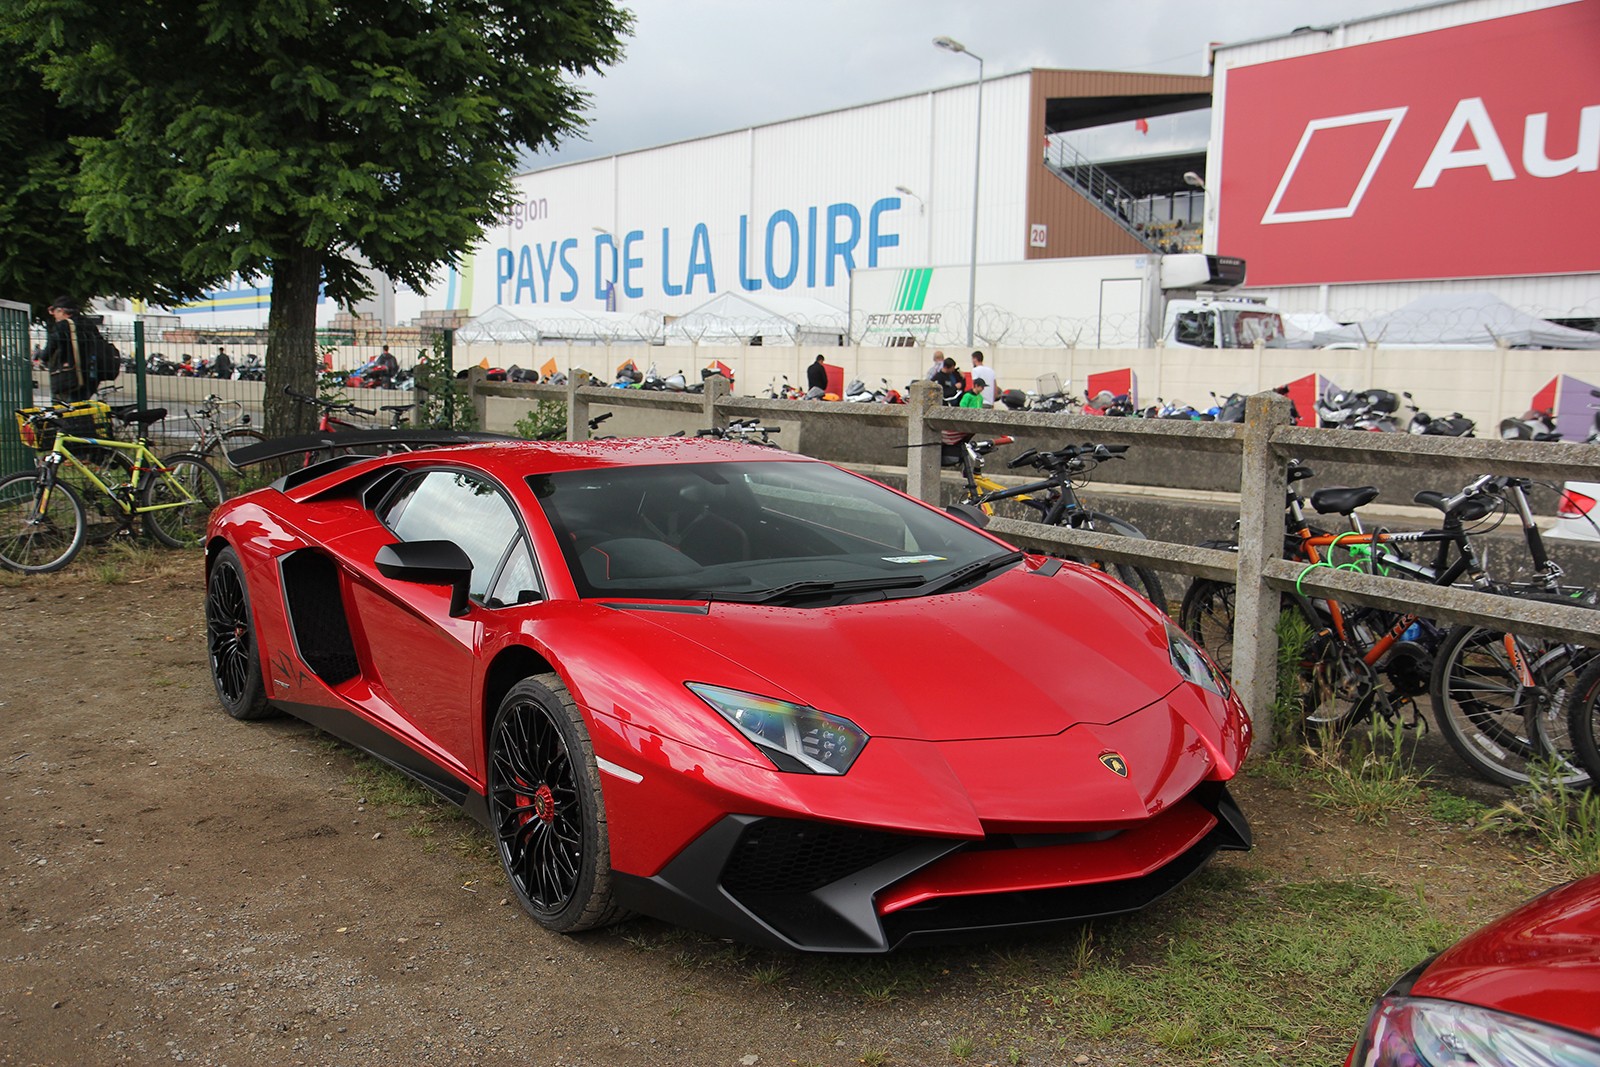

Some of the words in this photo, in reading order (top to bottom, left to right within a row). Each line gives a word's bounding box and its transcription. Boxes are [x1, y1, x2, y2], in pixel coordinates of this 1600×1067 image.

[1032, 229, 1046, 243] 20
[497, 238, 579, 305] PAYS
[594, 230, 644, 300] DE
[662, 222, 717, 296] LA
[867, 314, 891, 325] PETIT
[892, 313, 942, 325] FORESTIER
